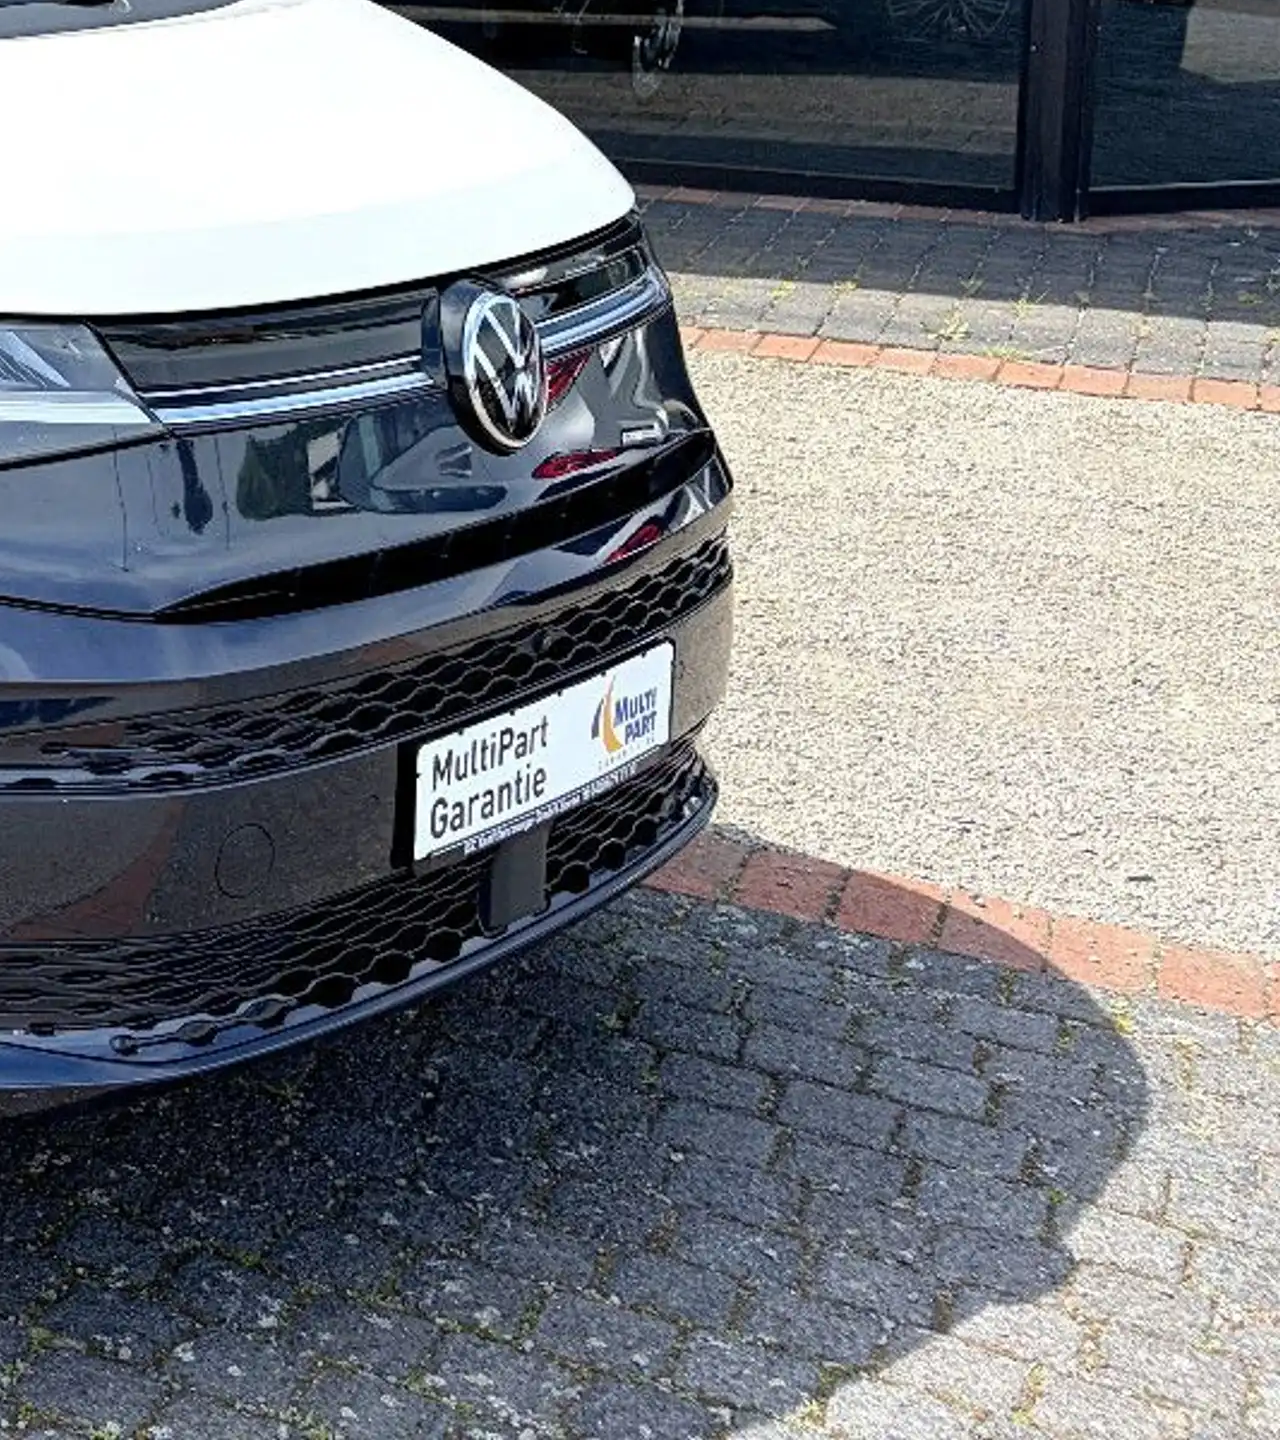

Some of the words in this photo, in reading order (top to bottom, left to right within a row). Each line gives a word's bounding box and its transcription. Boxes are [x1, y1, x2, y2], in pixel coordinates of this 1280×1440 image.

[614, 686, 658, 728] MULTI
[624, 711, 658, 745] PART
[432, 715, 549, 791] MultiPart
[430, 763, 547, 838] Garantie
